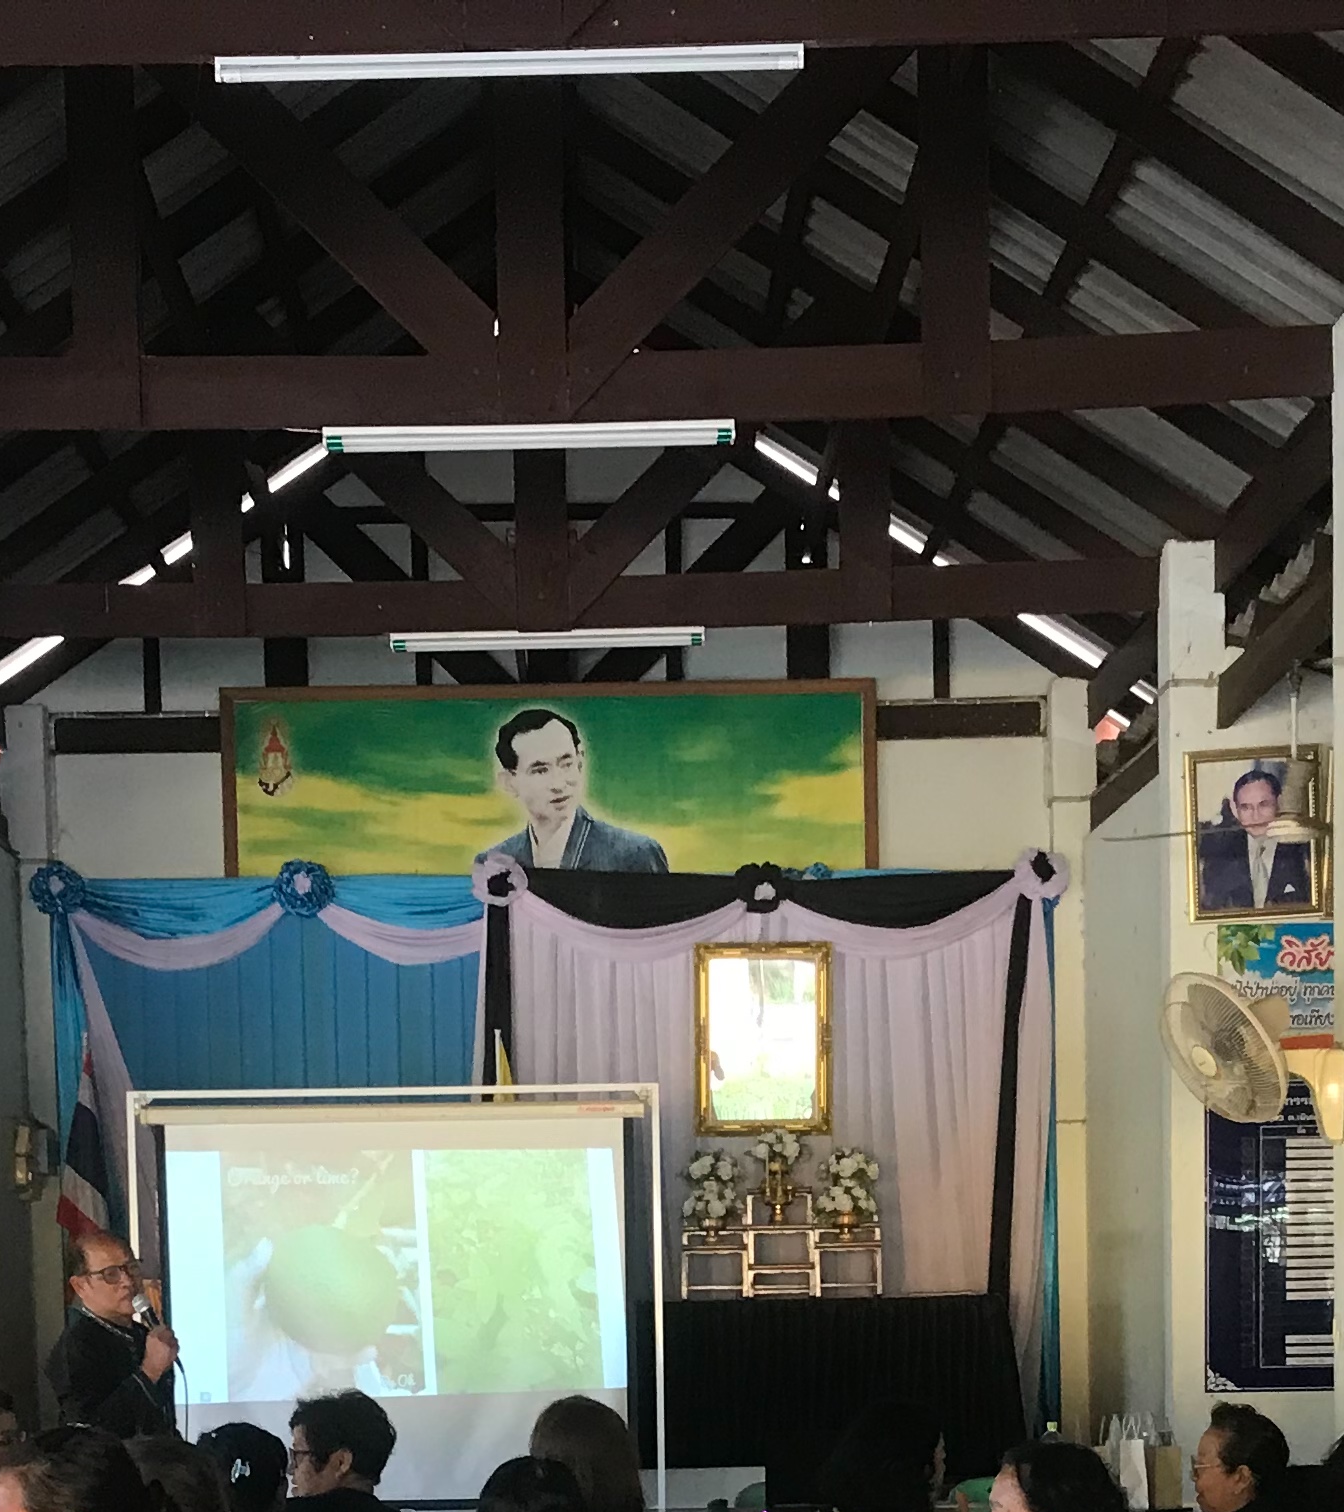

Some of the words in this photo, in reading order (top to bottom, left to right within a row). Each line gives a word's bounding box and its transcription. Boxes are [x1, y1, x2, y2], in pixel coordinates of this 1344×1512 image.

[1280, 938, 1334, 967] วิสัย
[227, 1166, 291, 1194] Orange
[293, 1174, 313, 1186] or
